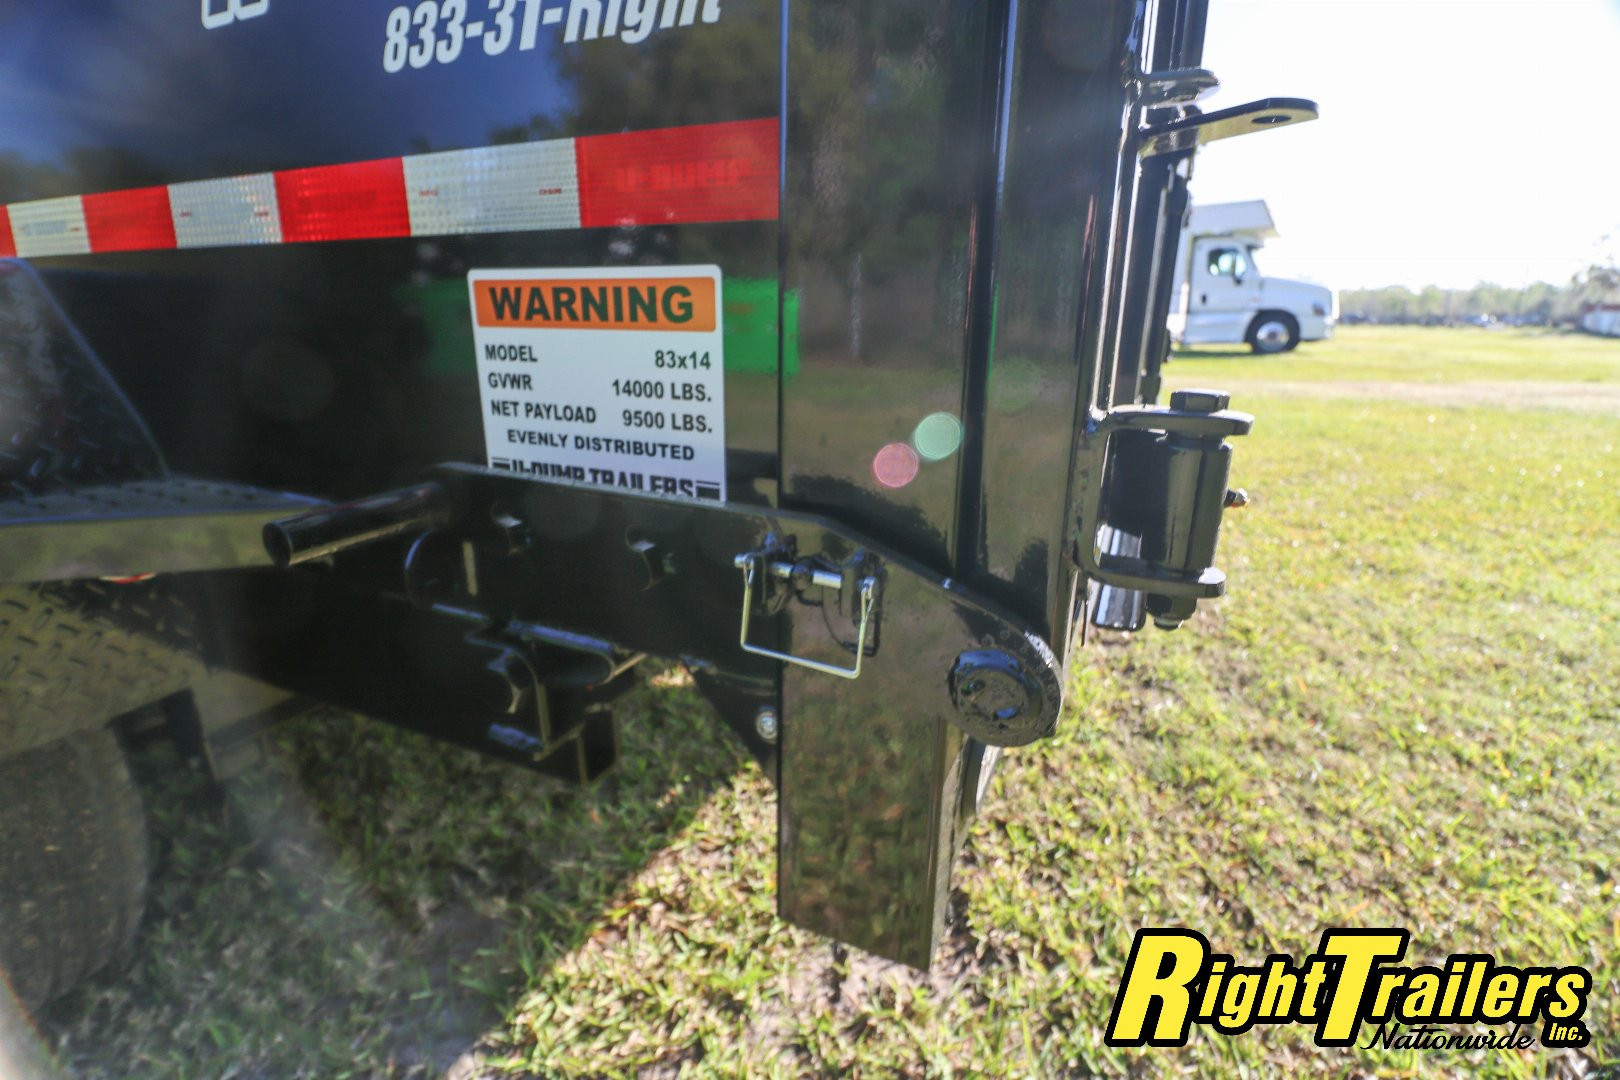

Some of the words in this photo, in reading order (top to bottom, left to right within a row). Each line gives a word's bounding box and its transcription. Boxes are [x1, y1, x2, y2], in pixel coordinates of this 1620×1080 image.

[488, 285, 693, 323] WARNING
[485, 344, 538, 362] MODEL
[655, 350, 711, 370] 83x14
[488, 372, 533, 391] GVWR
[612, 379, 664, 399] 14000
[671, 382, 712, 402] LBS.
[491, 400, 519, 417] NET
[525, 402, 597, 424] PAYLOAD
[622, 410, 665, 429] 9500
[671, 413, 713, 433] LBS.
[507, 429, 567, 448] EVENLY
[574, 435, 695, 461] DISTRIBUTED
